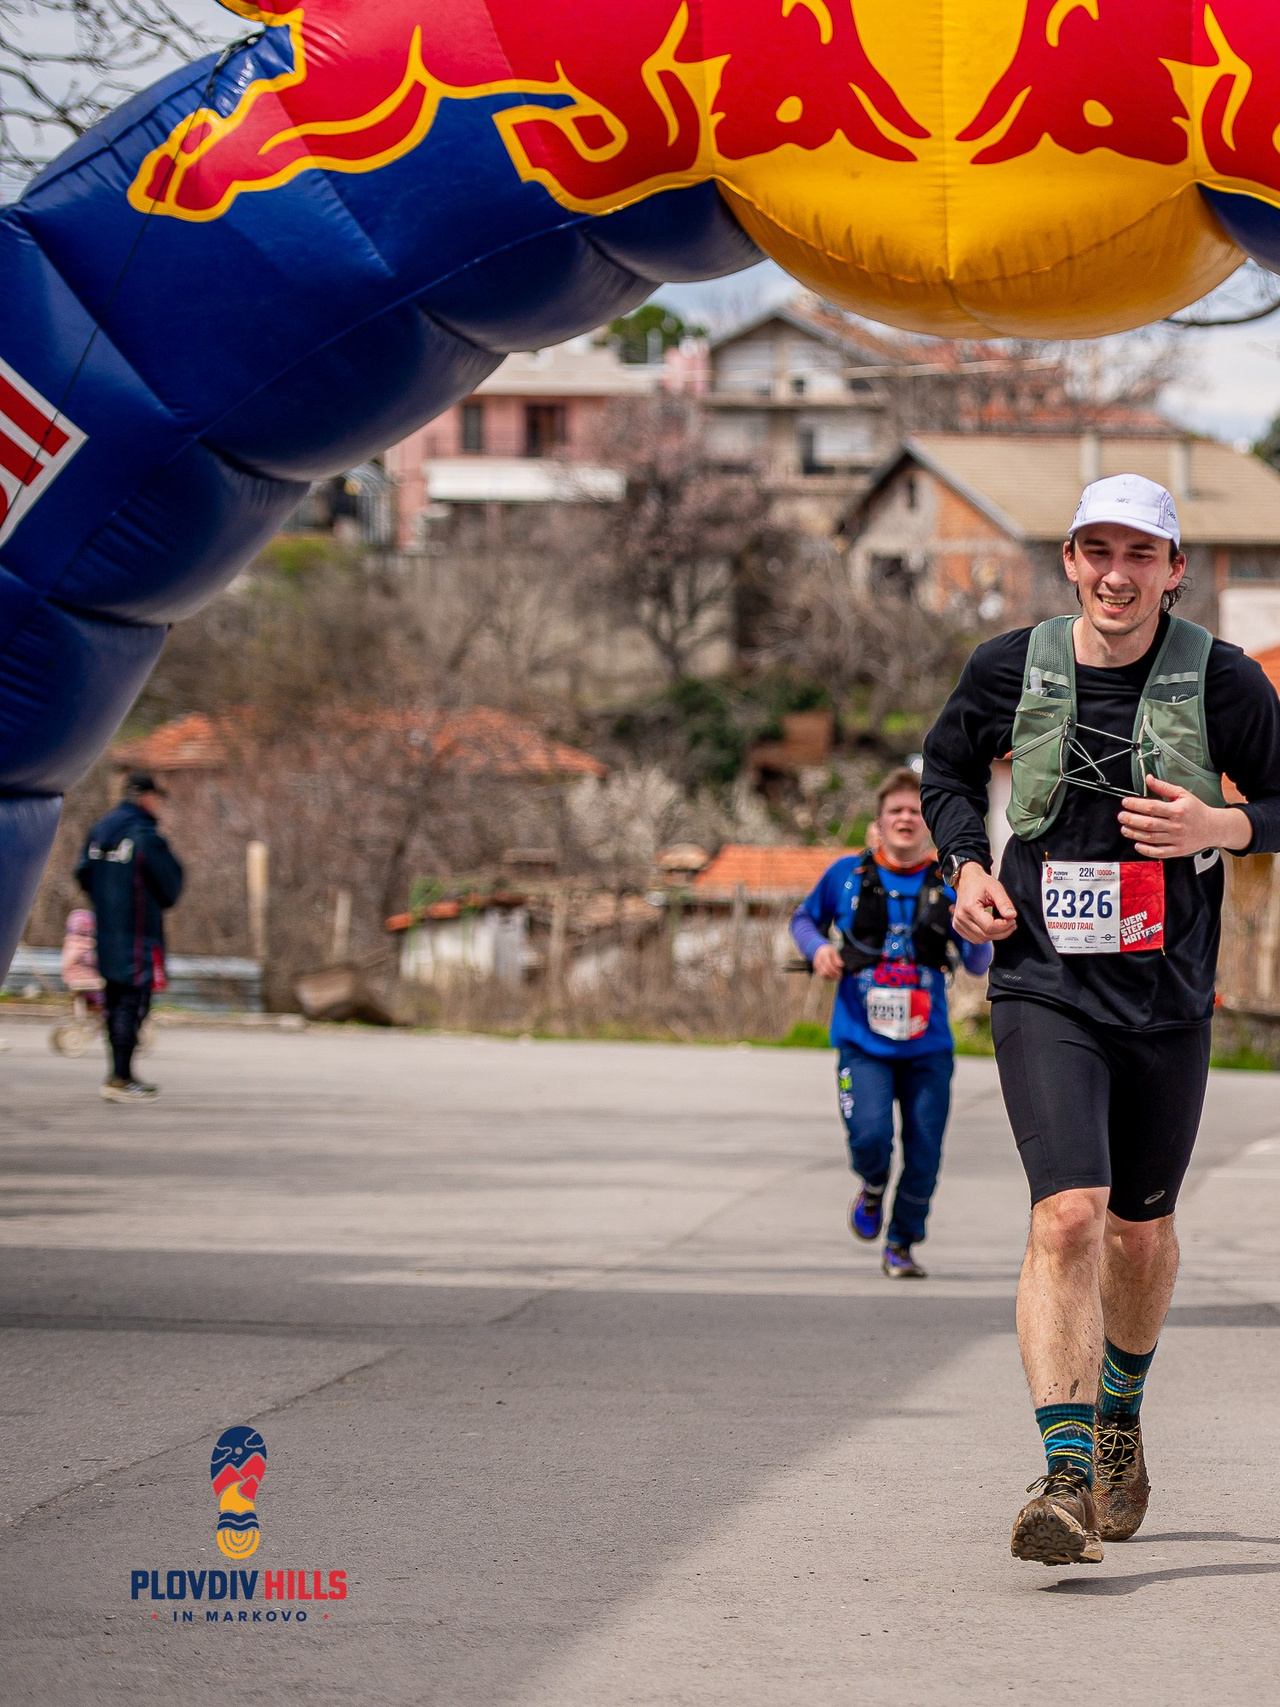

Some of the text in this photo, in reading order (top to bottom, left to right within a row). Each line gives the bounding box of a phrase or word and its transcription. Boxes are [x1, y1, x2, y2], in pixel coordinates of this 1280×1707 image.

[1079, 867, 1095, 878] 22K
[1046, 889, 1113, 919] 2326
[1047, 921, 1094, 931] MARKOVO TRAIL
[1120, 922, 1144, 938] STEP
